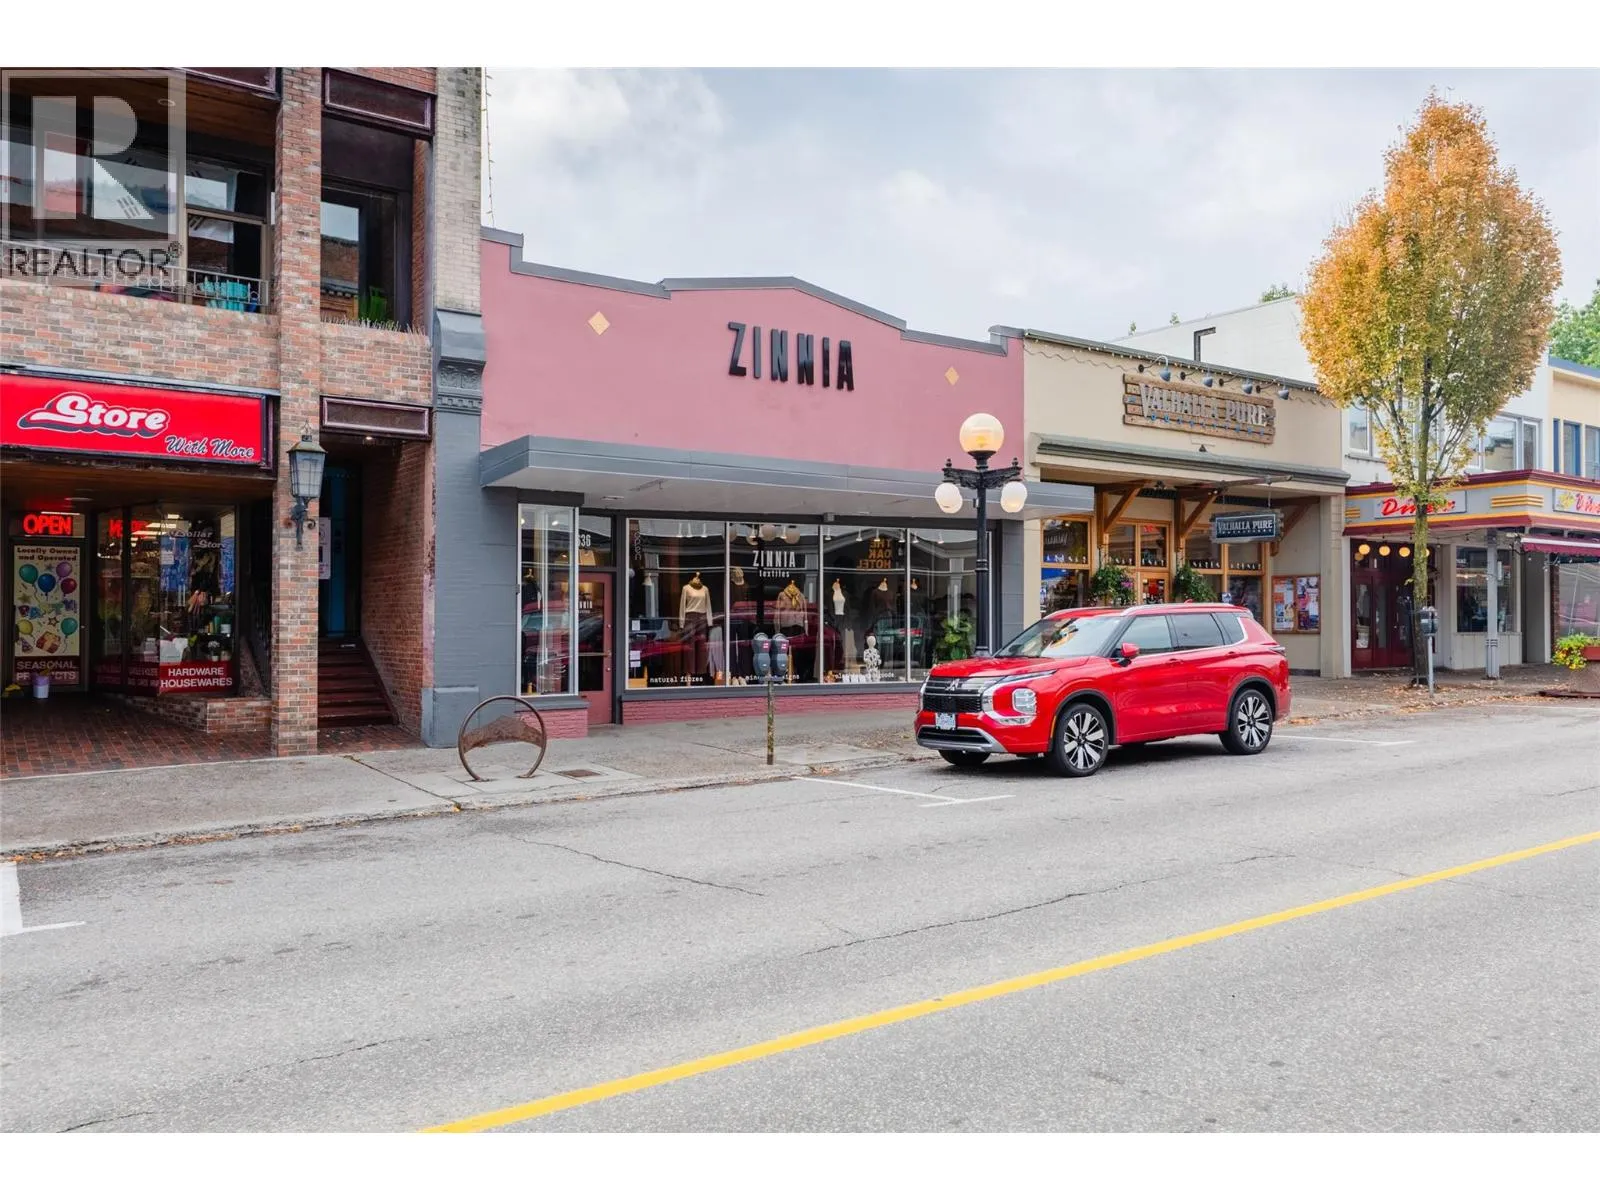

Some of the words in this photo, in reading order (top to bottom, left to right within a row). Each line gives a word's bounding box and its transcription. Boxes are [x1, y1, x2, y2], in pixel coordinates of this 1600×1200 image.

[728, 321, 854, 391] ZINNIA
[26, 393, 168, 433] Store
[1139, 383, 1219, 418] VALHALLA
[1225, 400, 1267, 427] PURE
[165, 435, 208, 455] With
[210, 438, 254, 458] More
[23, 513, 72, 535] OPEN
[1217, 521, 1250, 534] VALHALLA
[1252, 520, 1273, 529] PURE
[752, 550, 796, 568] ZINNIA
[759, 570, 790, 578] textiles
[16, 660, 78, 670] SEASONAL
[167, 667, 224, 677] HARDWARE
[16, 671, 76, 681] PRCTS
[160, 677, 233, 688] HOUSEWARES
